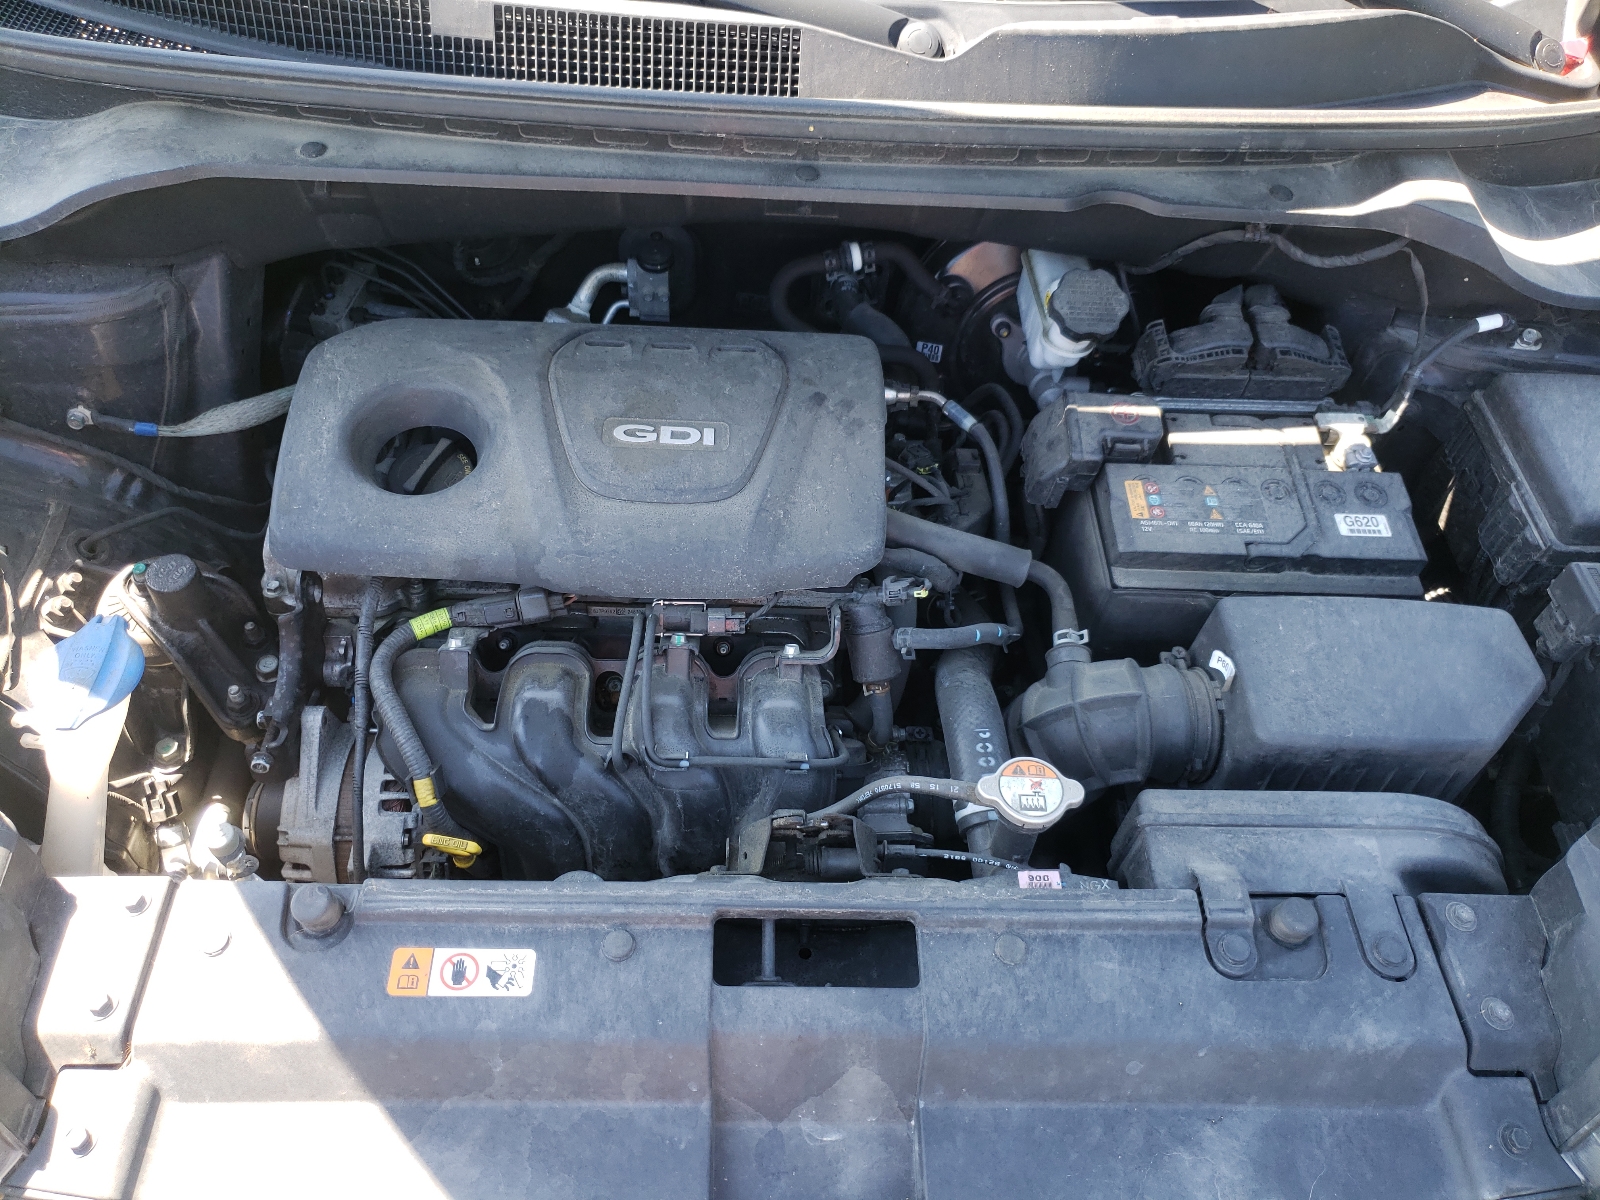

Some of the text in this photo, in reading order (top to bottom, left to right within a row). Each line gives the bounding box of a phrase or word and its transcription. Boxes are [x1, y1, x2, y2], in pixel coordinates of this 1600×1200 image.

[921, 342, 940, 355] P40
[613, 423, 716, 446] GDI
[456, 453, 469, 464] SEE
[1343, 515, 1380, 528] G620
[950, 785, 959, 793] 21
[451, 838, 467, 850] OIL
